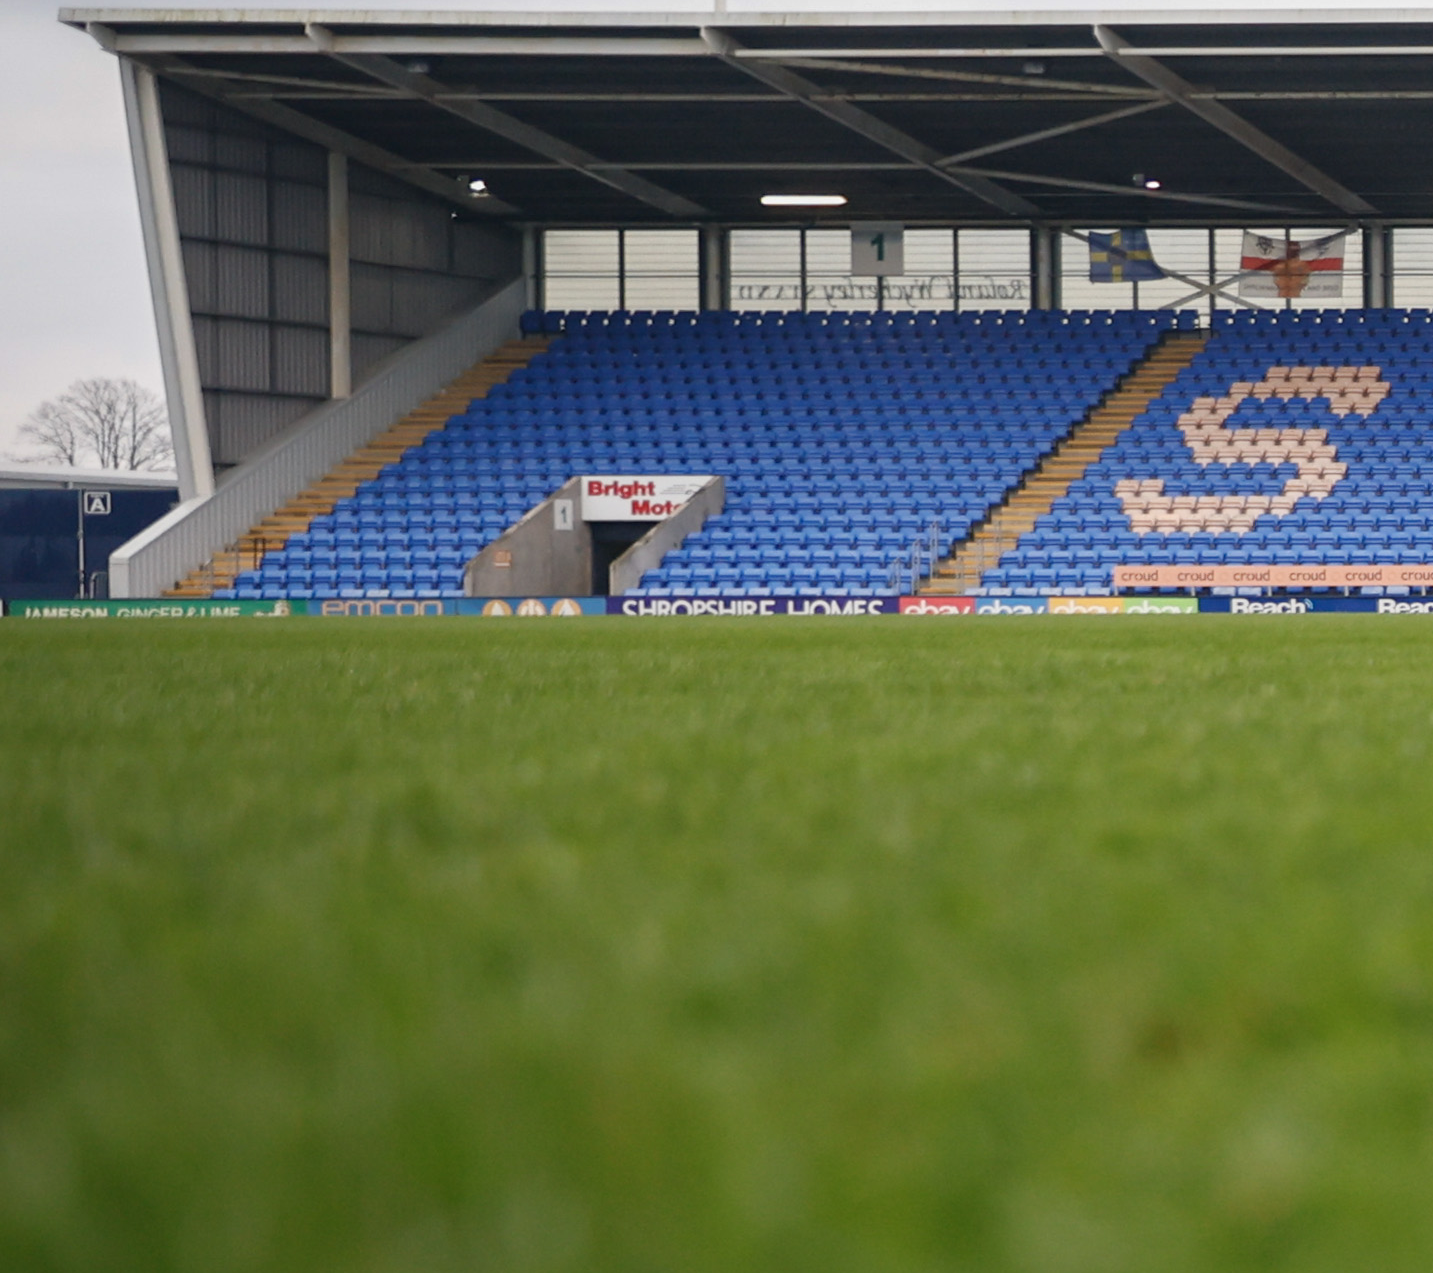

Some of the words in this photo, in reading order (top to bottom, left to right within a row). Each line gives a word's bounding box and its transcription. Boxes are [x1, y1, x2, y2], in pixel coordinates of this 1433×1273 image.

[871, 233, 884, 261] 1
[588, 481, 655, 498] Bright
[89, 498, 106, 511] A
[560, 506, 568, 523] 1
[1121, 570, 1159, 582] croud
[1177, 570, 1214, 582] croud
[1233, 570, 1270, 582] croud
[1289, 570, 1326, 582] croud
[1345, 569, 1382, 581] croud
[623, 600, 775, 615] SHROPSHIRE
[787, 600, 883, 615] HOMES
[1232, 599, 1305, 614] Reach
